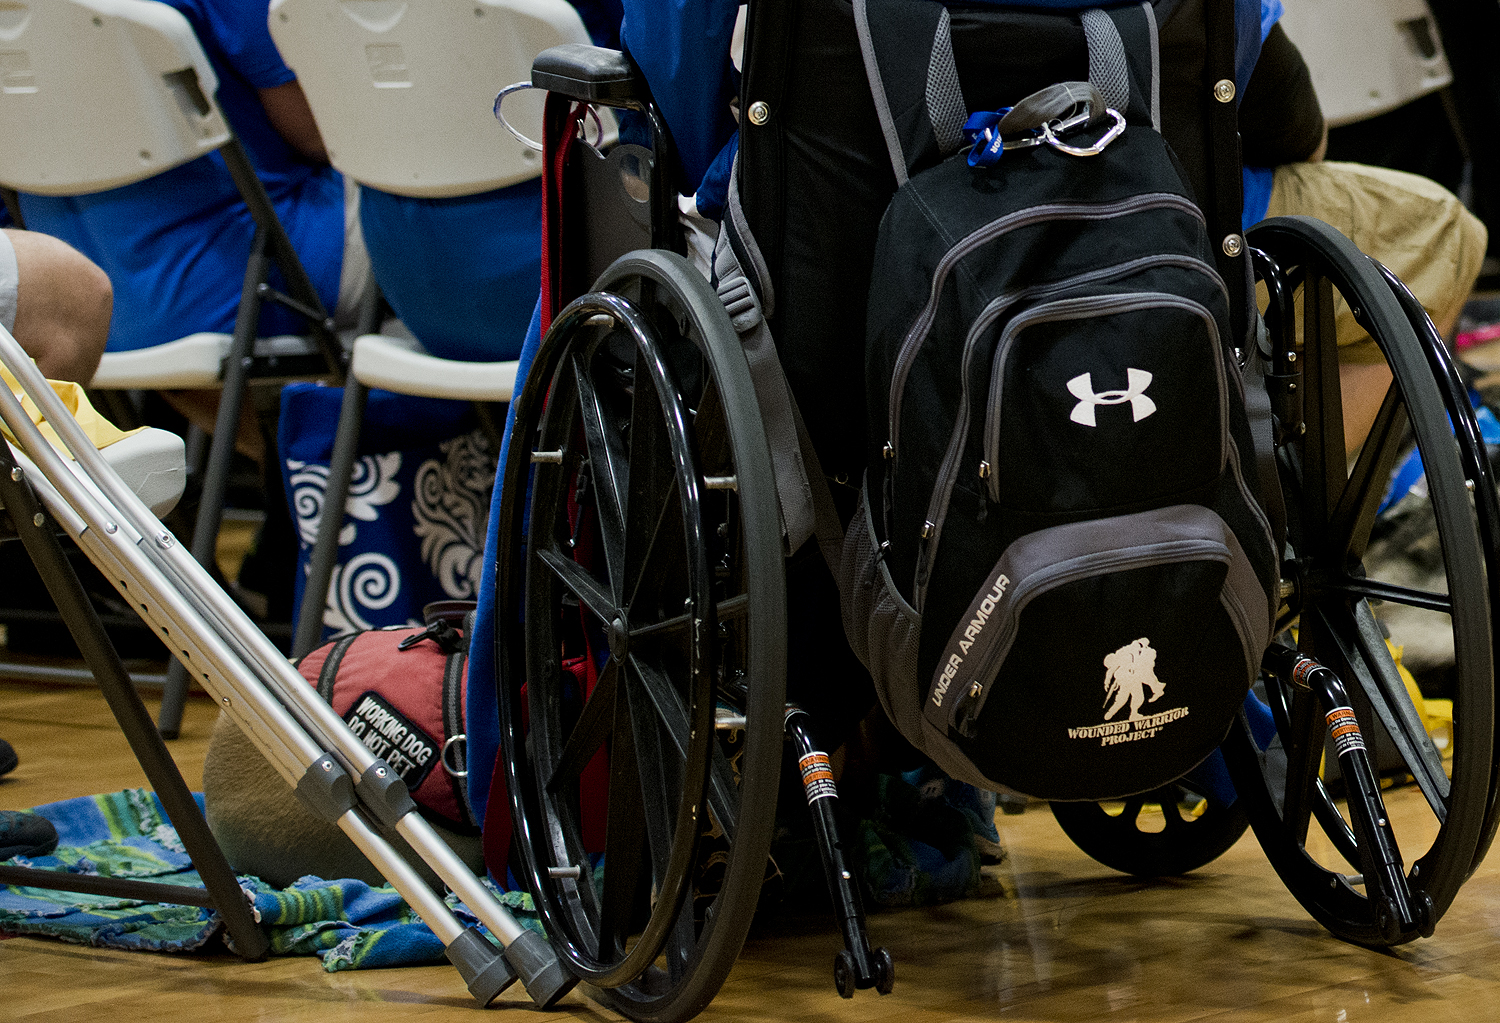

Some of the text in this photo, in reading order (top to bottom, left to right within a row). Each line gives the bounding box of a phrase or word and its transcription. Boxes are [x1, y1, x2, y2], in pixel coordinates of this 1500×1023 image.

[932, 574, 1011, 707] UNDER ARMOUR
[348, 716, 416, 778] DO NOT PET
[356, 696, 433, 766] WORKING DOG
[1067, 707, 1190, 739] WOUNDED WARRIOR
